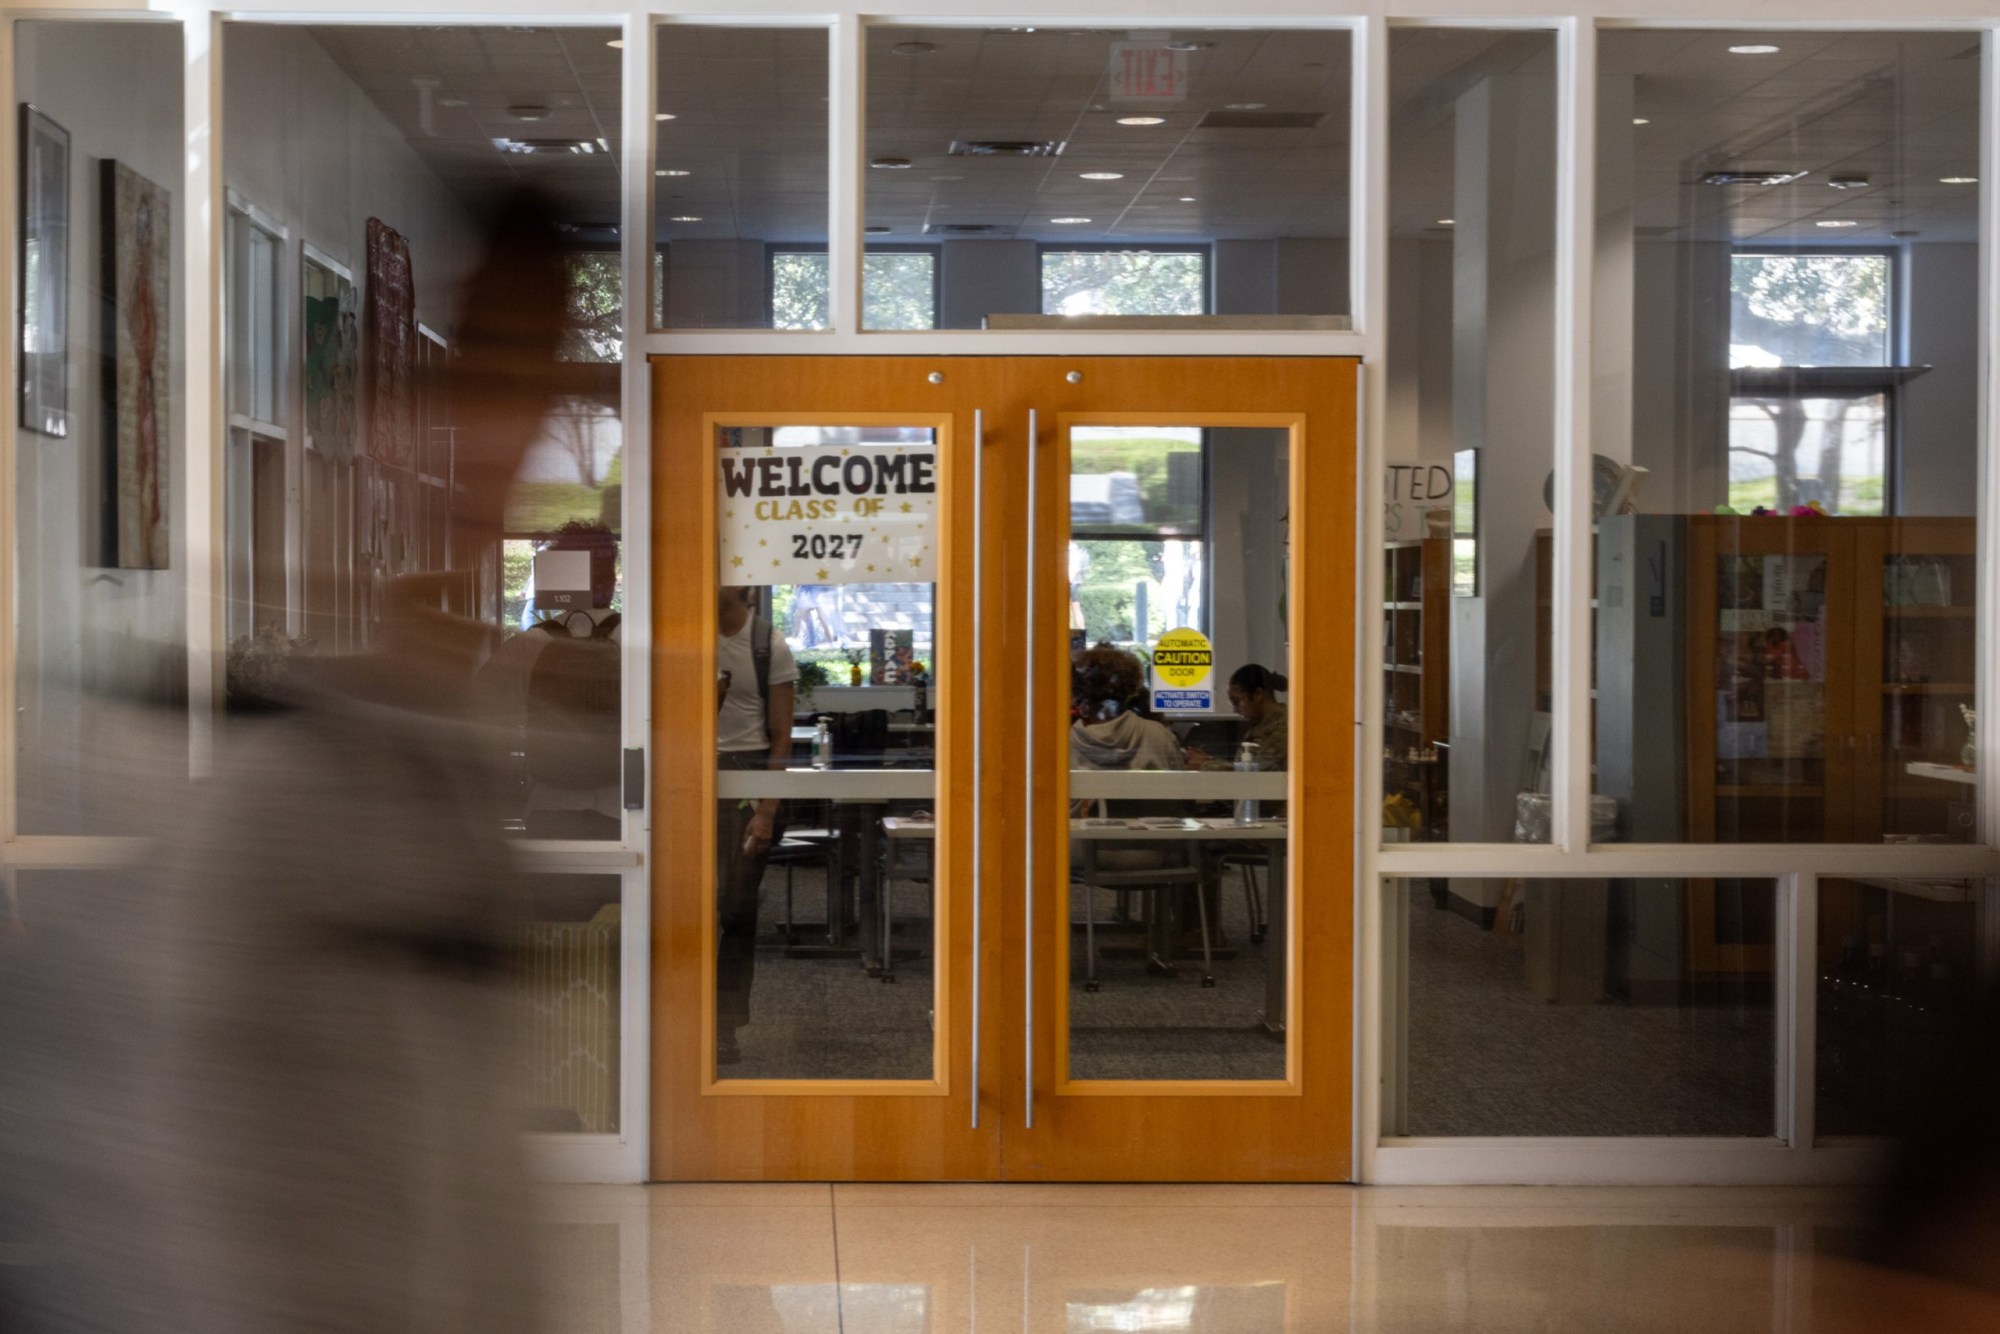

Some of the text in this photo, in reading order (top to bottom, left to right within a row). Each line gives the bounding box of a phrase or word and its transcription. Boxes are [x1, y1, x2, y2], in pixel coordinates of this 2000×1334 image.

[721, 453, 936, 498] WELCOME
[754, 497, 885, 521] CLASS OF
[792, 533, 864, 560] 2027
[1158, 639, 1207, 648] AUTOMATIC
[1155, 652, 1210, 664] CAUTION
[1169, 667, 1195, 677] DOOR
[1156, 691, 1209, 699] ACTIVATE SWITCH
[1163, 700, 1202, 708] TO OPERATE
